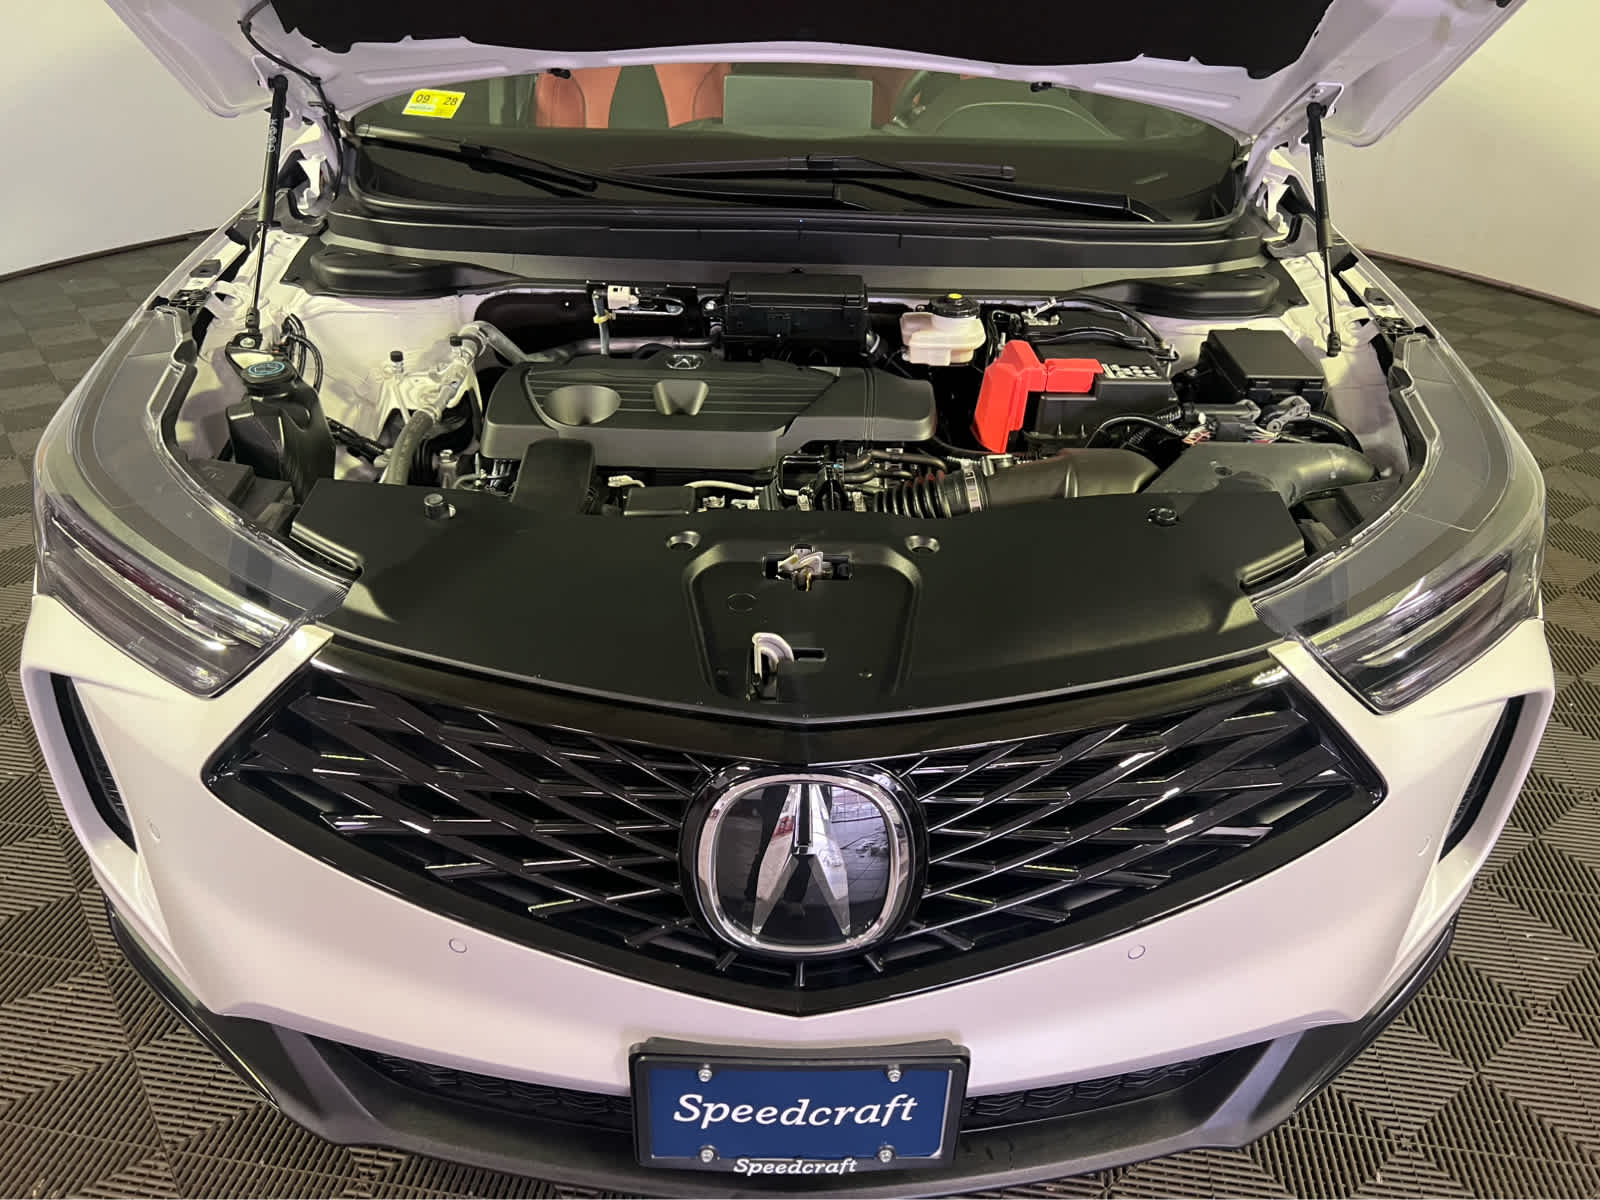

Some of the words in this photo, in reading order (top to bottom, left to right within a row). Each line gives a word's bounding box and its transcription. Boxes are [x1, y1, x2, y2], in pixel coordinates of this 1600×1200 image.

[416, 94, 430, 103] 09
[443, 96, 458, 105] 28
[673, 1093, 918, 1129] Speedcraft
[733, 1158, 857, 1176] Speedcraft
